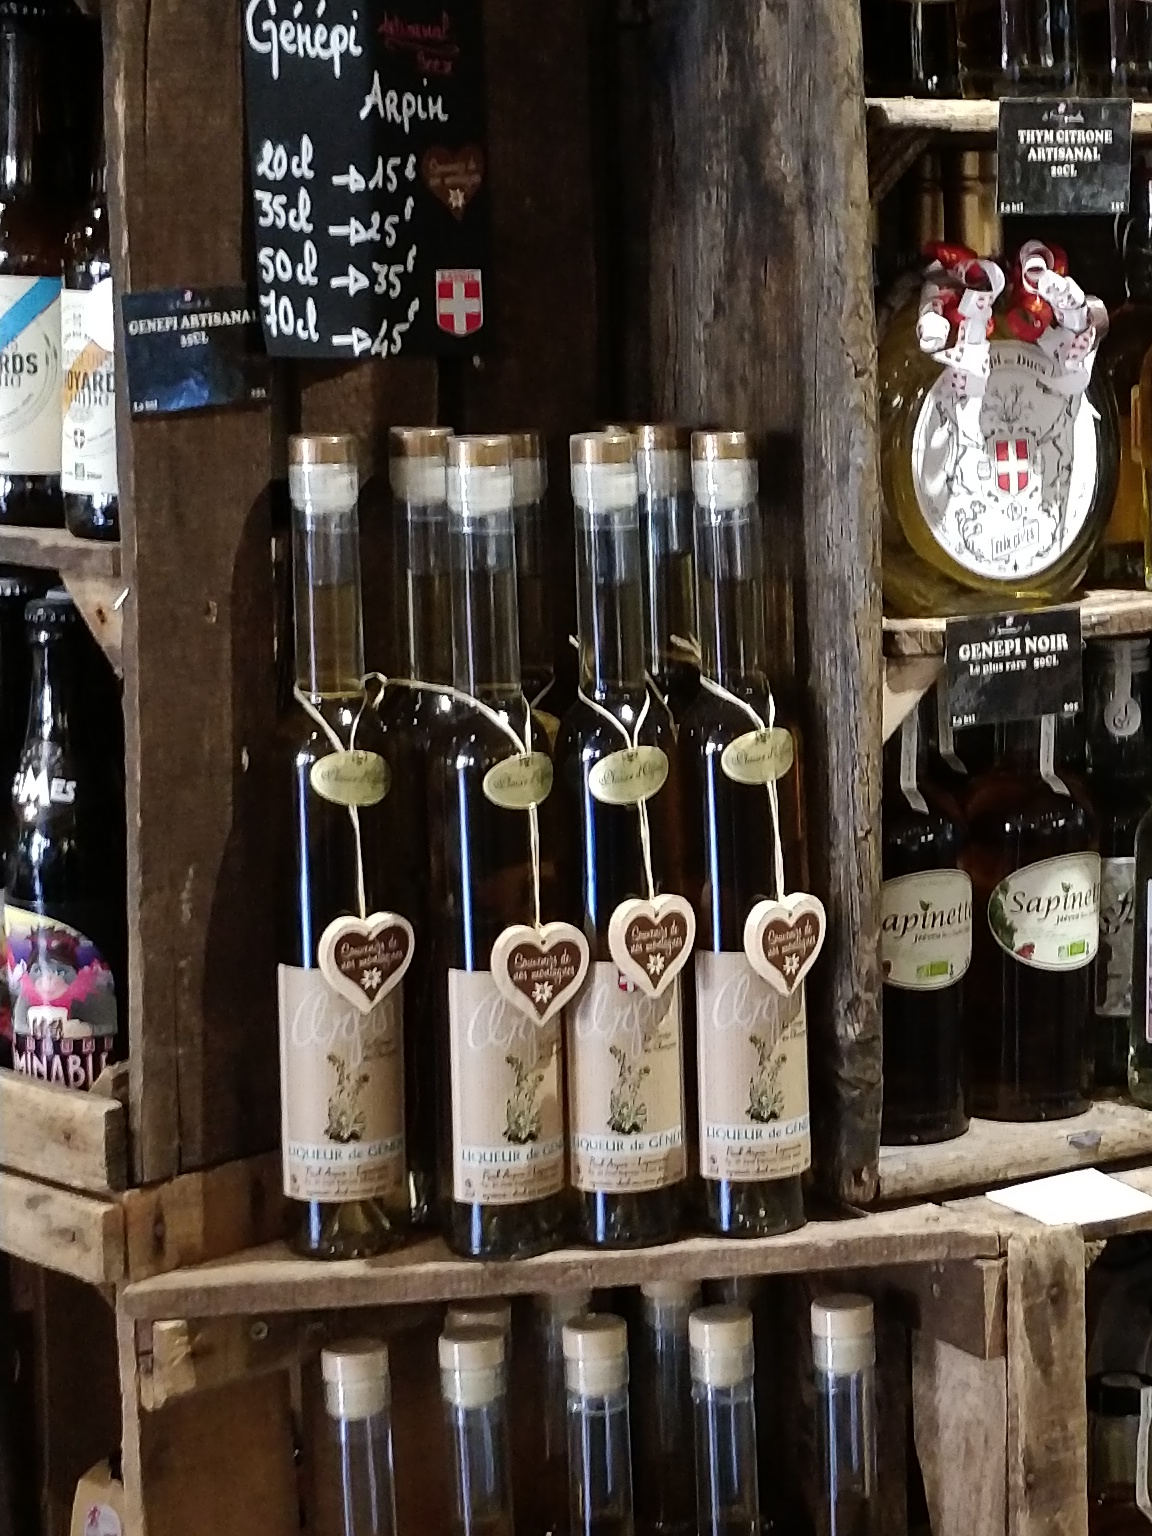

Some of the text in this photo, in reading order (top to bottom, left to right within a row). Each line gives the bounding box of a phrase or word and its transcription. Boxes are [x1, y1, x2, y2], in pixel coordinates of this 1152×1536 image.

[1018, 129, 1113, 145] THYM CITRONE
[256, 133, 315, 181] 20cl
[1027, 146, 1101, 162] ARTISANAL
[254, 185, 314, 234] 35cl
[258, 240, 319, 287] 50cl
[128, 316, 178, 336] GENEPI
[260, 289, 320, 344] 70cl
[958, 632, 1069, 662] GENEPI NOIR
[982, 659, 1027, 676] plus rare
[881, 902, 973, 941] apinett
[629, 1135, 645, 1150] de
[706, 1124, 782, 1141] LIQUEUR de
[461, 1148, 540, 1163] LIQUEUR de
